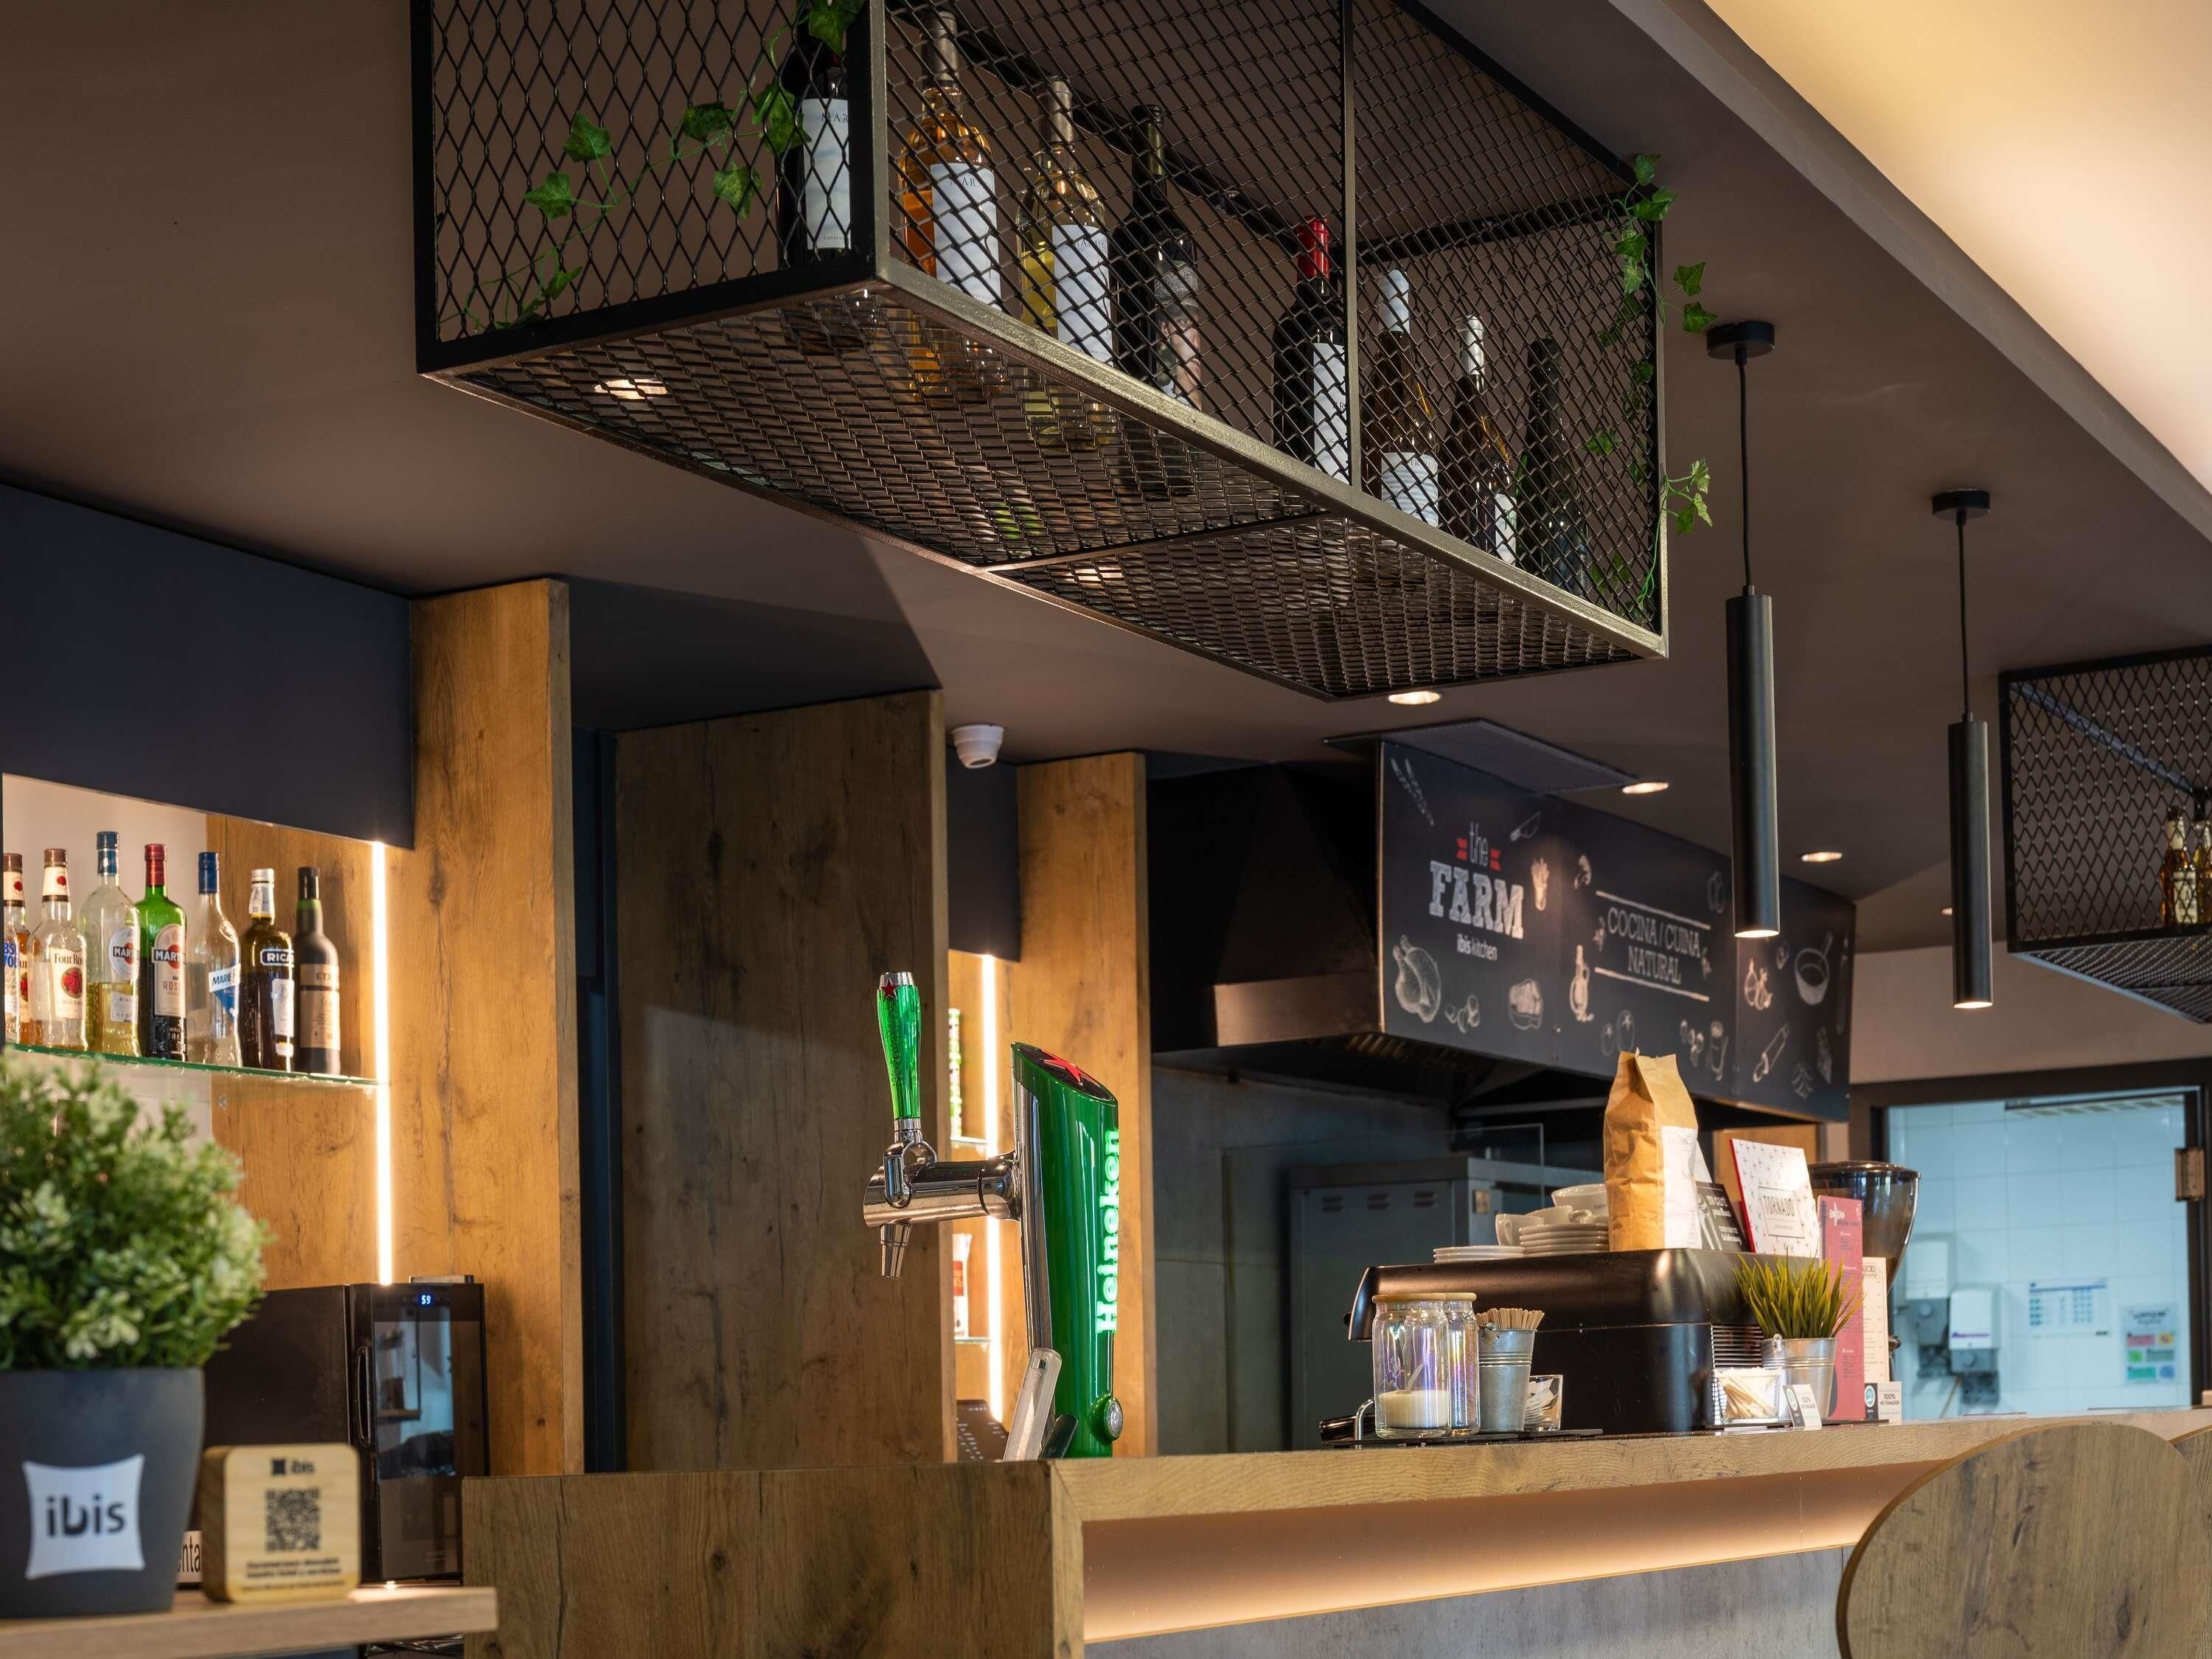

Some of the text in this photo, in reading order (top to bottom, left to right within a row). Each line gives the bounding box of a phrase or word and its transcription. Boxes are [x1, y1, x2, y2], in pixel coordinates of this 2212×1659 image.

[1469, 821, 1489, 868] the
[1429, 860, 1524, 940] FARM
[54, 953, 73, 964] Four
[1456, 932, 1498, 961] ibis kitchen
[1627, 945, 1682, 985] NATURAL
[211, 973, 232, 986] MARIE
[1762, 1194, 1795, 1217] TORNADO
[1096, 1127, 1120, 1334] Heineken
[290, 1460, 315, 1475] ibis
[45, 1493, 125, 1538] ibis
[177, 1535, 201, 1573] nta
